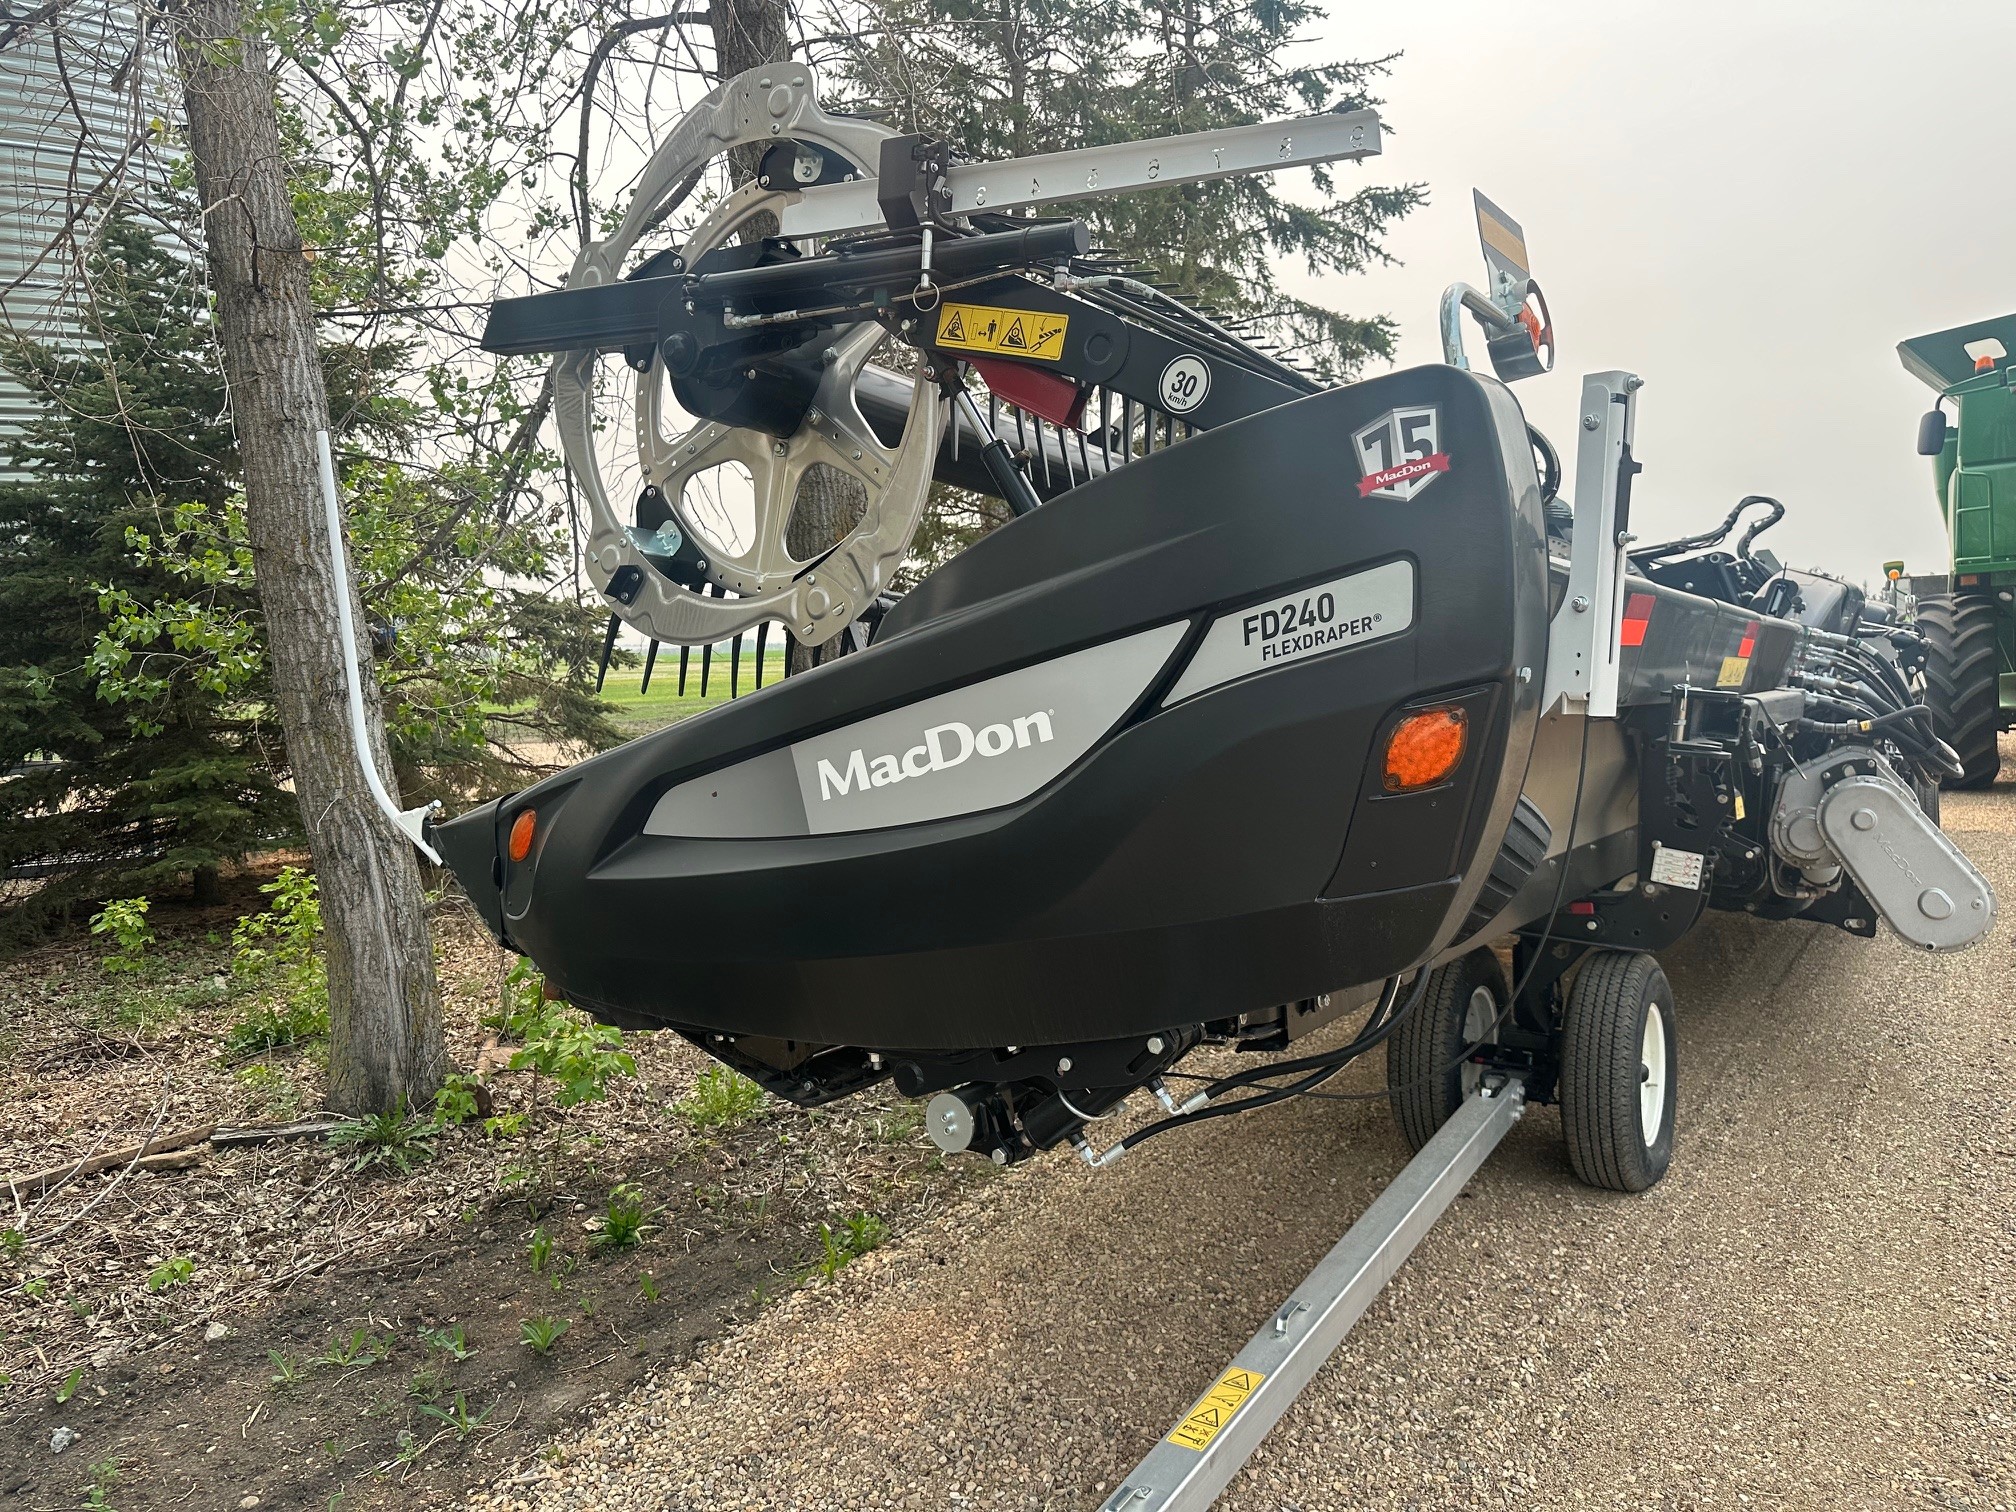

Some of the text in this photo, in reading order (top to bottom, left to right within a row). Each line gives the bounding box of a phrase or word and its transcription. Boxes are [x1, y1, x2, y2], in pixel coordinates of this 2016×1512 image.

[1171, 370, 1198, 398] 30
[1167, 392, 1188, 407] km/h
[1375, 461, 1432, 485] MacDon
[1242, 592, 1335, 647] FD240
